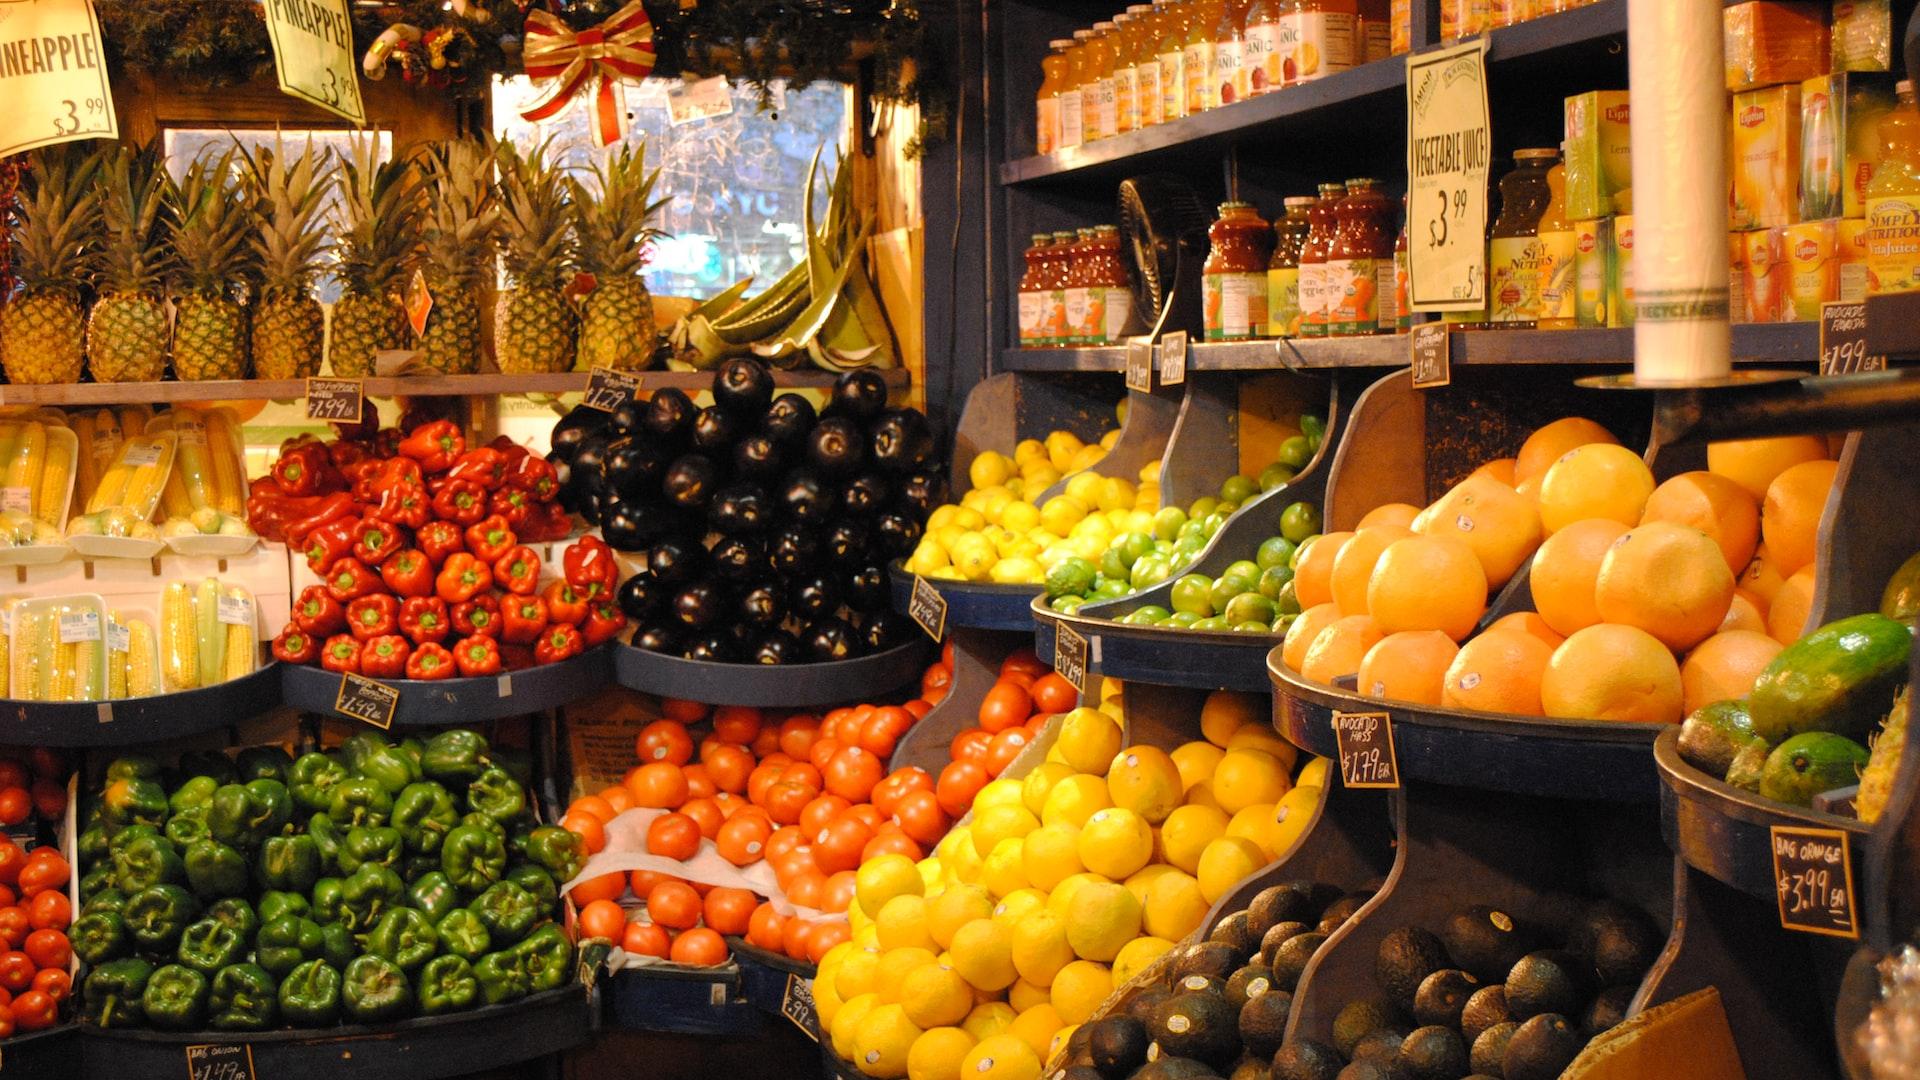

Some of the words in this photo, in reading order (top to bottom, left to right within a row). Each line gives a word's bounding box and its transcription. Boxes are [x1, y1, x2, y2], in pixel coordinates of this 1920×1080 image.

[272, 0, 345, 49] PINEAPPLE
[53, 98, 104, 136] $3.99
[1414, 132, 1460, 177] VEGETABLE
[1463, 127, 1484, 176] JUICE
[1429, 189, 1467, 250] $3.99
[1340, 717, 1378, 731] AVOCADO
[1350, 729, 1372, 742] HASS
[1343, 748, 1380, 784] $1.79
[1377, 762, 1390, 779] EA
[1776, 837, 1797, 859] BAG
[1800, 842, 1842, 864] ORANGE
[1779, 868, 1828, 913] $3.99
